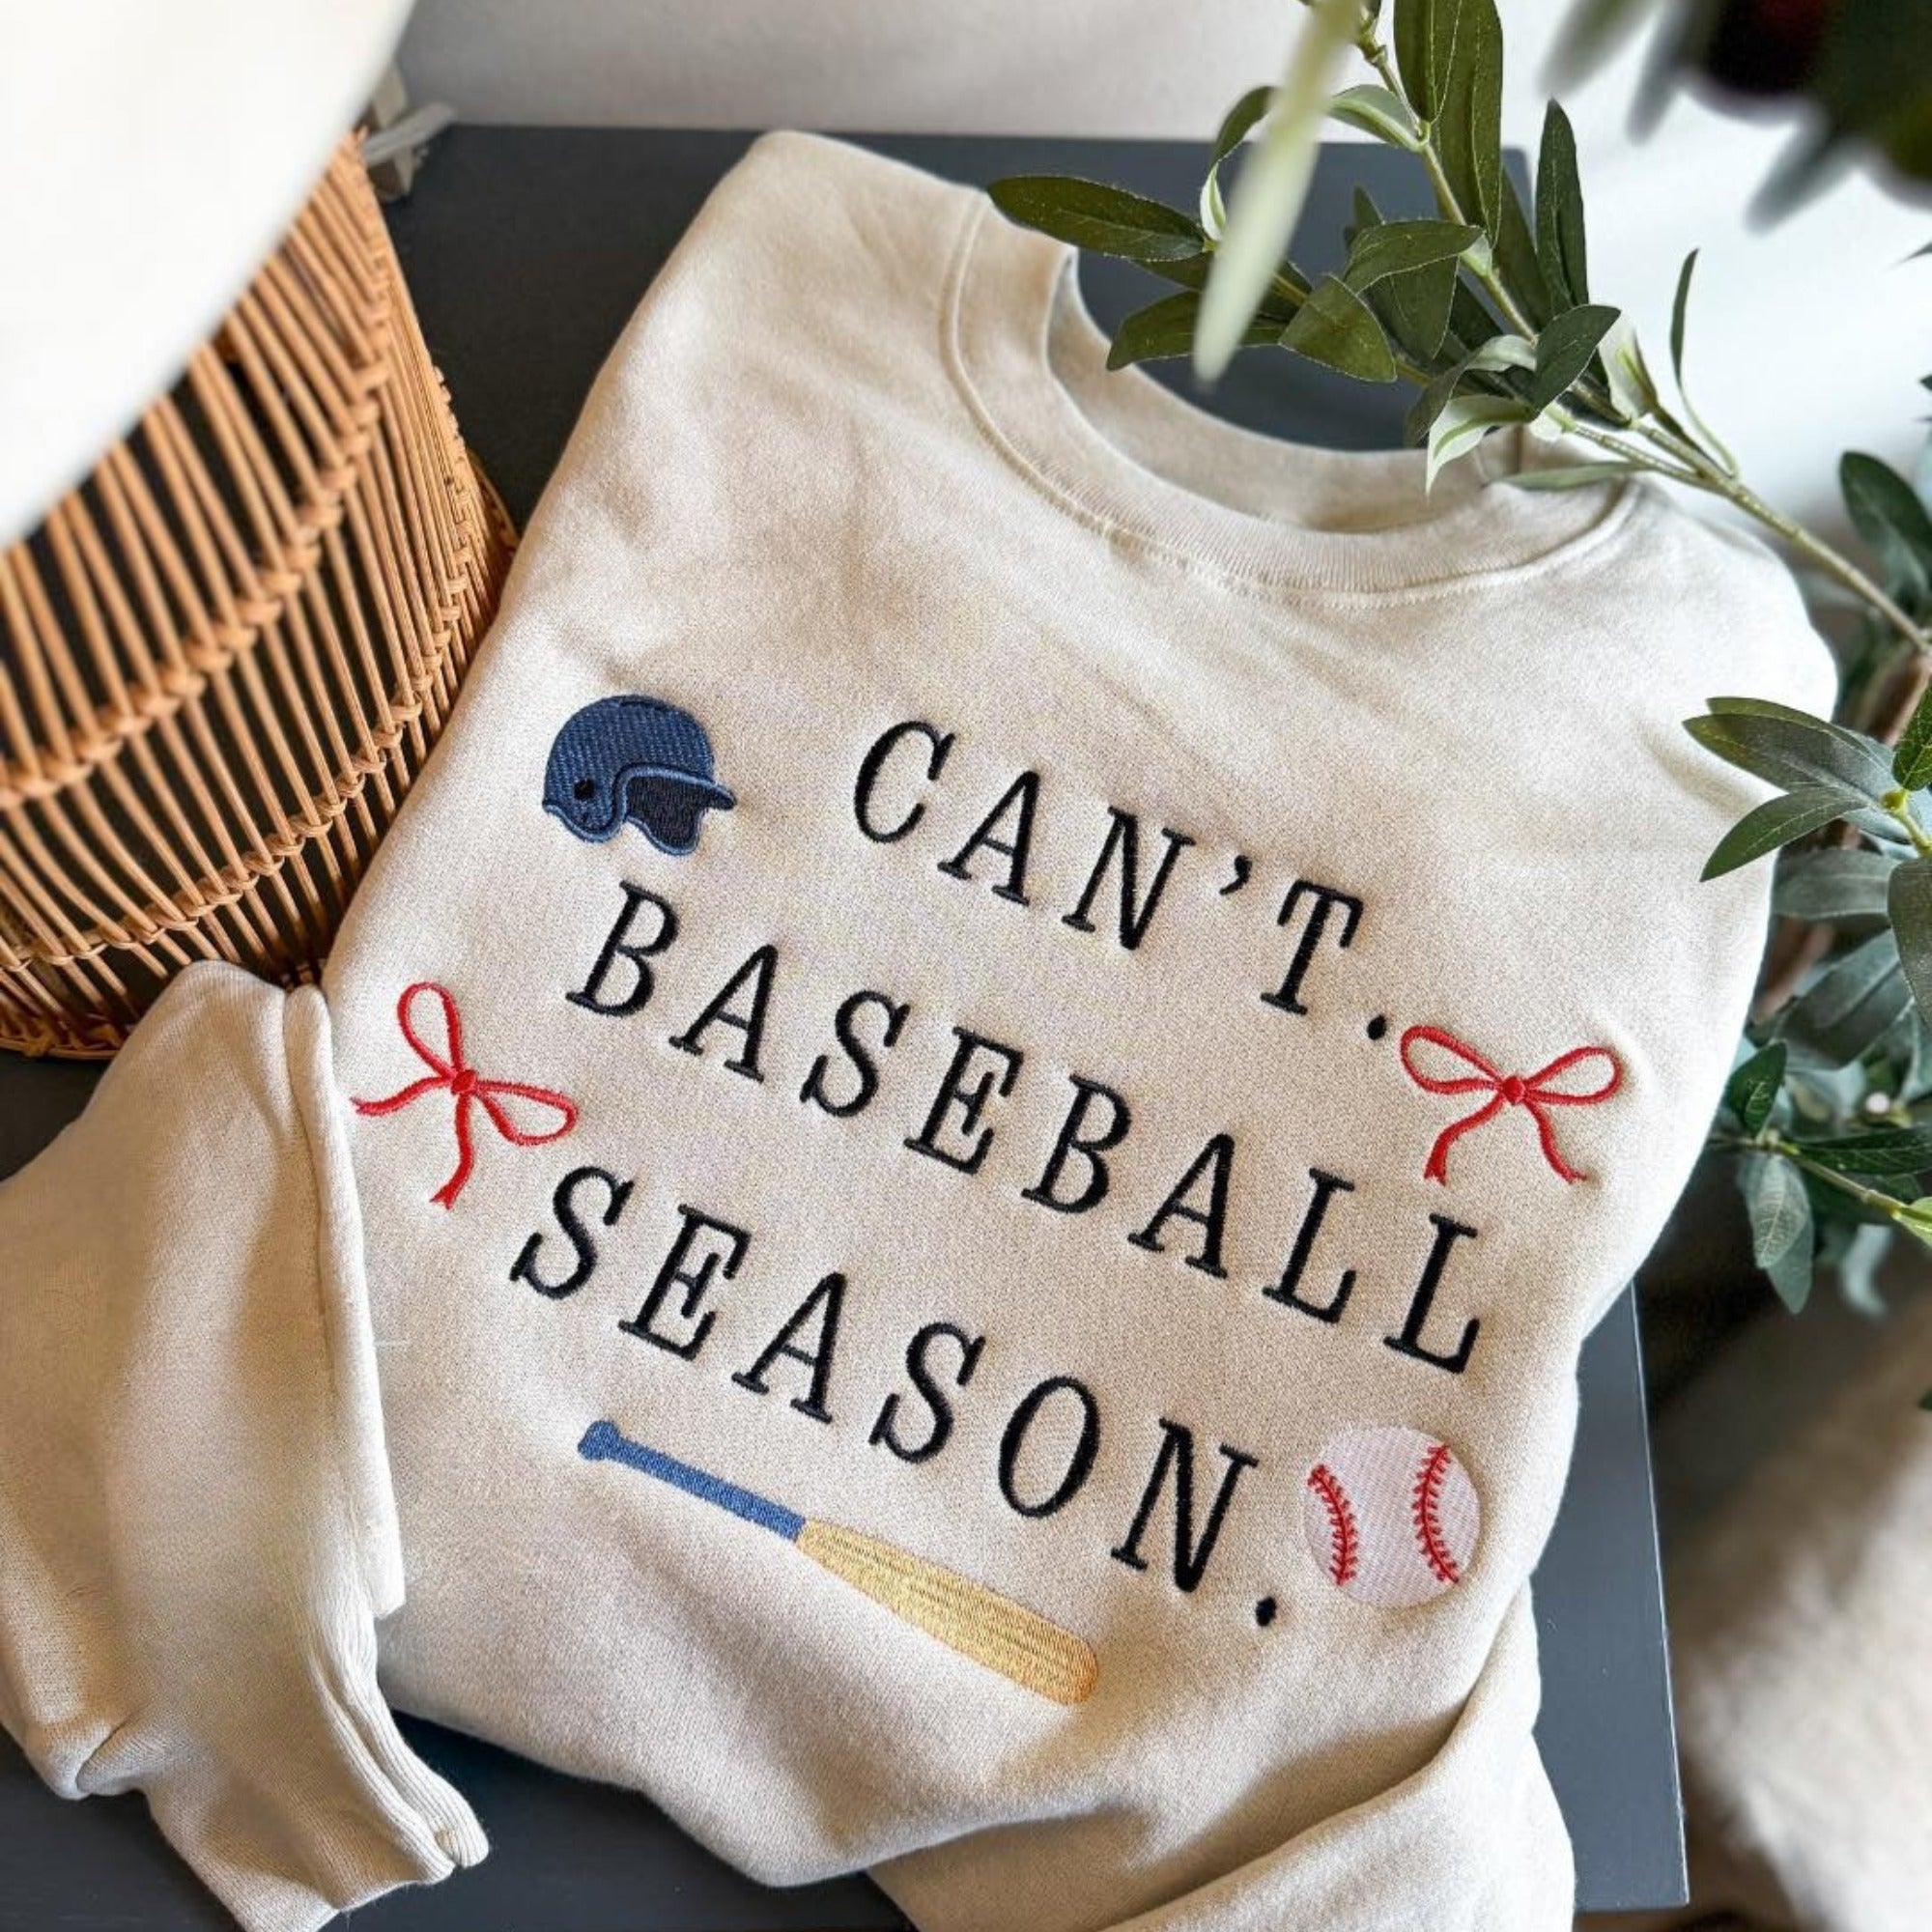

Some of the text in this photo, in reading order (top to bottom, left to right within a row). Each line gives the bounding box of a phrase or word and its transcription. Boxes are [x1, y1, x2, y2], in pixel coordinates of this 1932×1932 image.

[853, 720, 1388, 1041] CAN’T.
[565, 880, 1481, 1376] BASEBALL
[509, 1166, 1278, 1628] SEASON.
